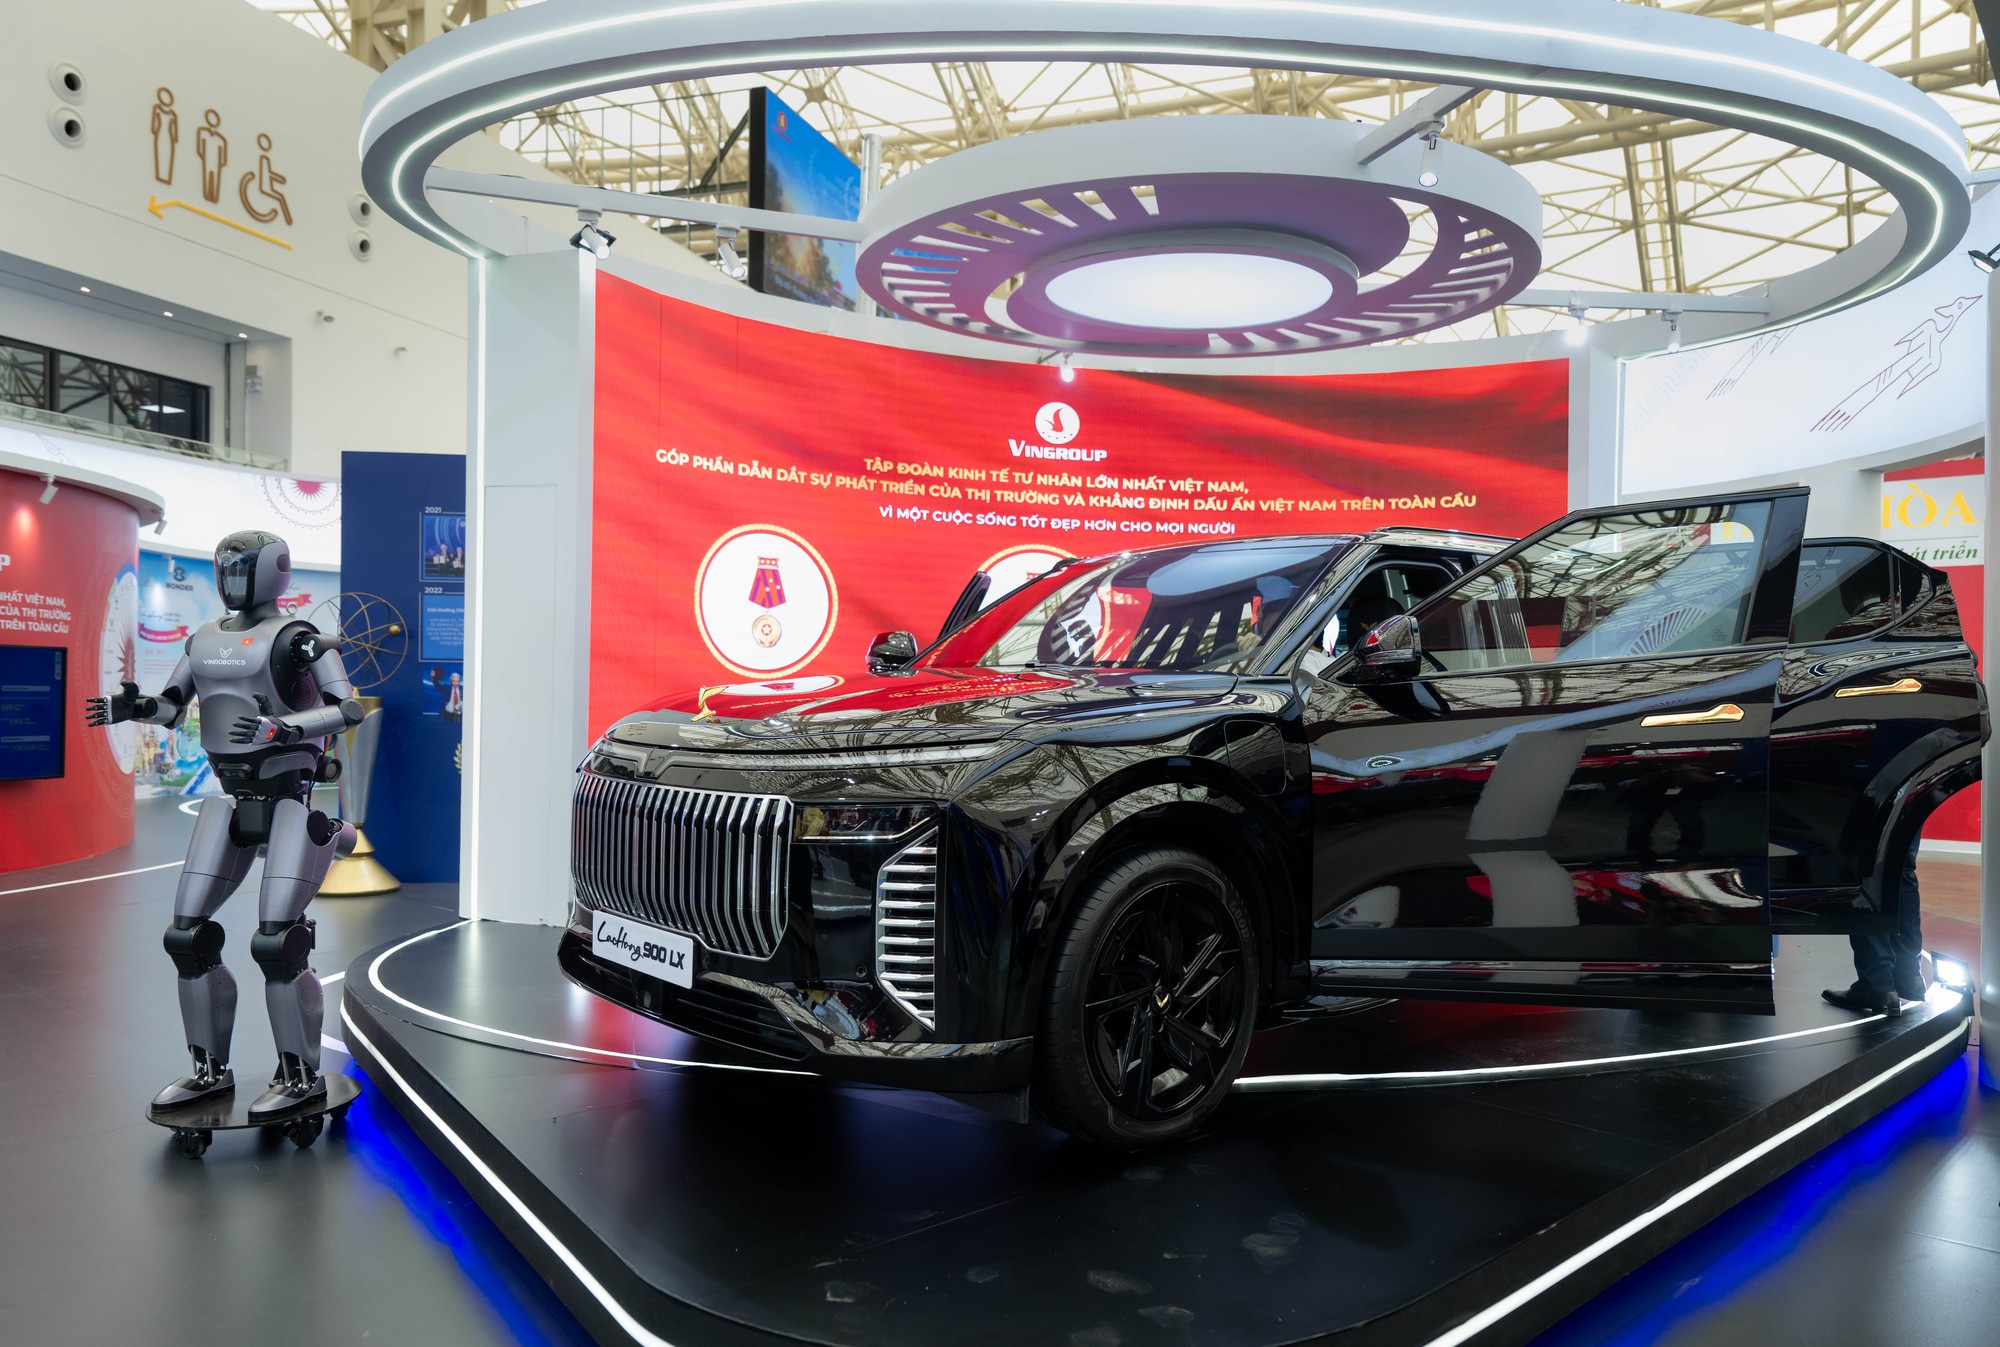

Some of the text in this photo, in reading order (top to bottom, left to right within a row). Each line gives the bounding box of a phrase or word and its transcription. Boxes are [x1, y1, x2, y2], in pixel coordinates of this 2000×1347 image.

[1008, 439, 1107, 461] VINGROUP
[656, 448, 689, 465] GÓP
[693, 456, 734, 474] PHẦN
[738, 460, 772, 479] DẪN
[810, 473, 832, 489] SỰ
[835, 475, 877, 491] PHÁT
[879, 479, 925, 496] TRIỂN
[929, 482, 962, 499] CỦA
[965, 488, 990, 504] THỊ
[994, 490, 1060, 505] TRƯỜNG
[1063, 492, 1085, 506] VÀ
[1089, 492, 1145, 509] KHẲNG
[1148, 498, 1189, 512] ĐỊNH
[1194, 496, 1228, 511] DẤU
[1231, 496, 1255, 511] ẤN
[1259, 497, 1295, 514] VIỆT
[1299, 500, 1336, 511] NAM
[1340, 496, 1384, 511] TRÊN
[1388, 495, 1436, 509] TOÀN
[1440, 492, 1476, 508] CẦU
[864, 457, 1248, 494] TẬP ĐOÀN KINH TẾ TƯ NHÂN LỚN NHẤT VIỆT NAM,
[425, 506, 442, 514] 2021
[879, 504, 1235, 535] VÌ MỘT CUỘC SỐNG TỐT ĐẸP HƠN CHO MỌI NGƯỜI
[1933, 540, 1978, 560] triển
[165, 583, 194, 592] WONDER
[424, 586, 443, 594] 2022
[25, 592, 44, 606] VIỆT
[46, 596, 66, 608] NAM,
[0, 603, 71, 621] CỦA THỊ TRƯỜNG
[0, 618, 26, 630] TRÊN
[27, 621, 51, 632] TOÀN
[597, 921, 685, 970] LacHong 900 LX
